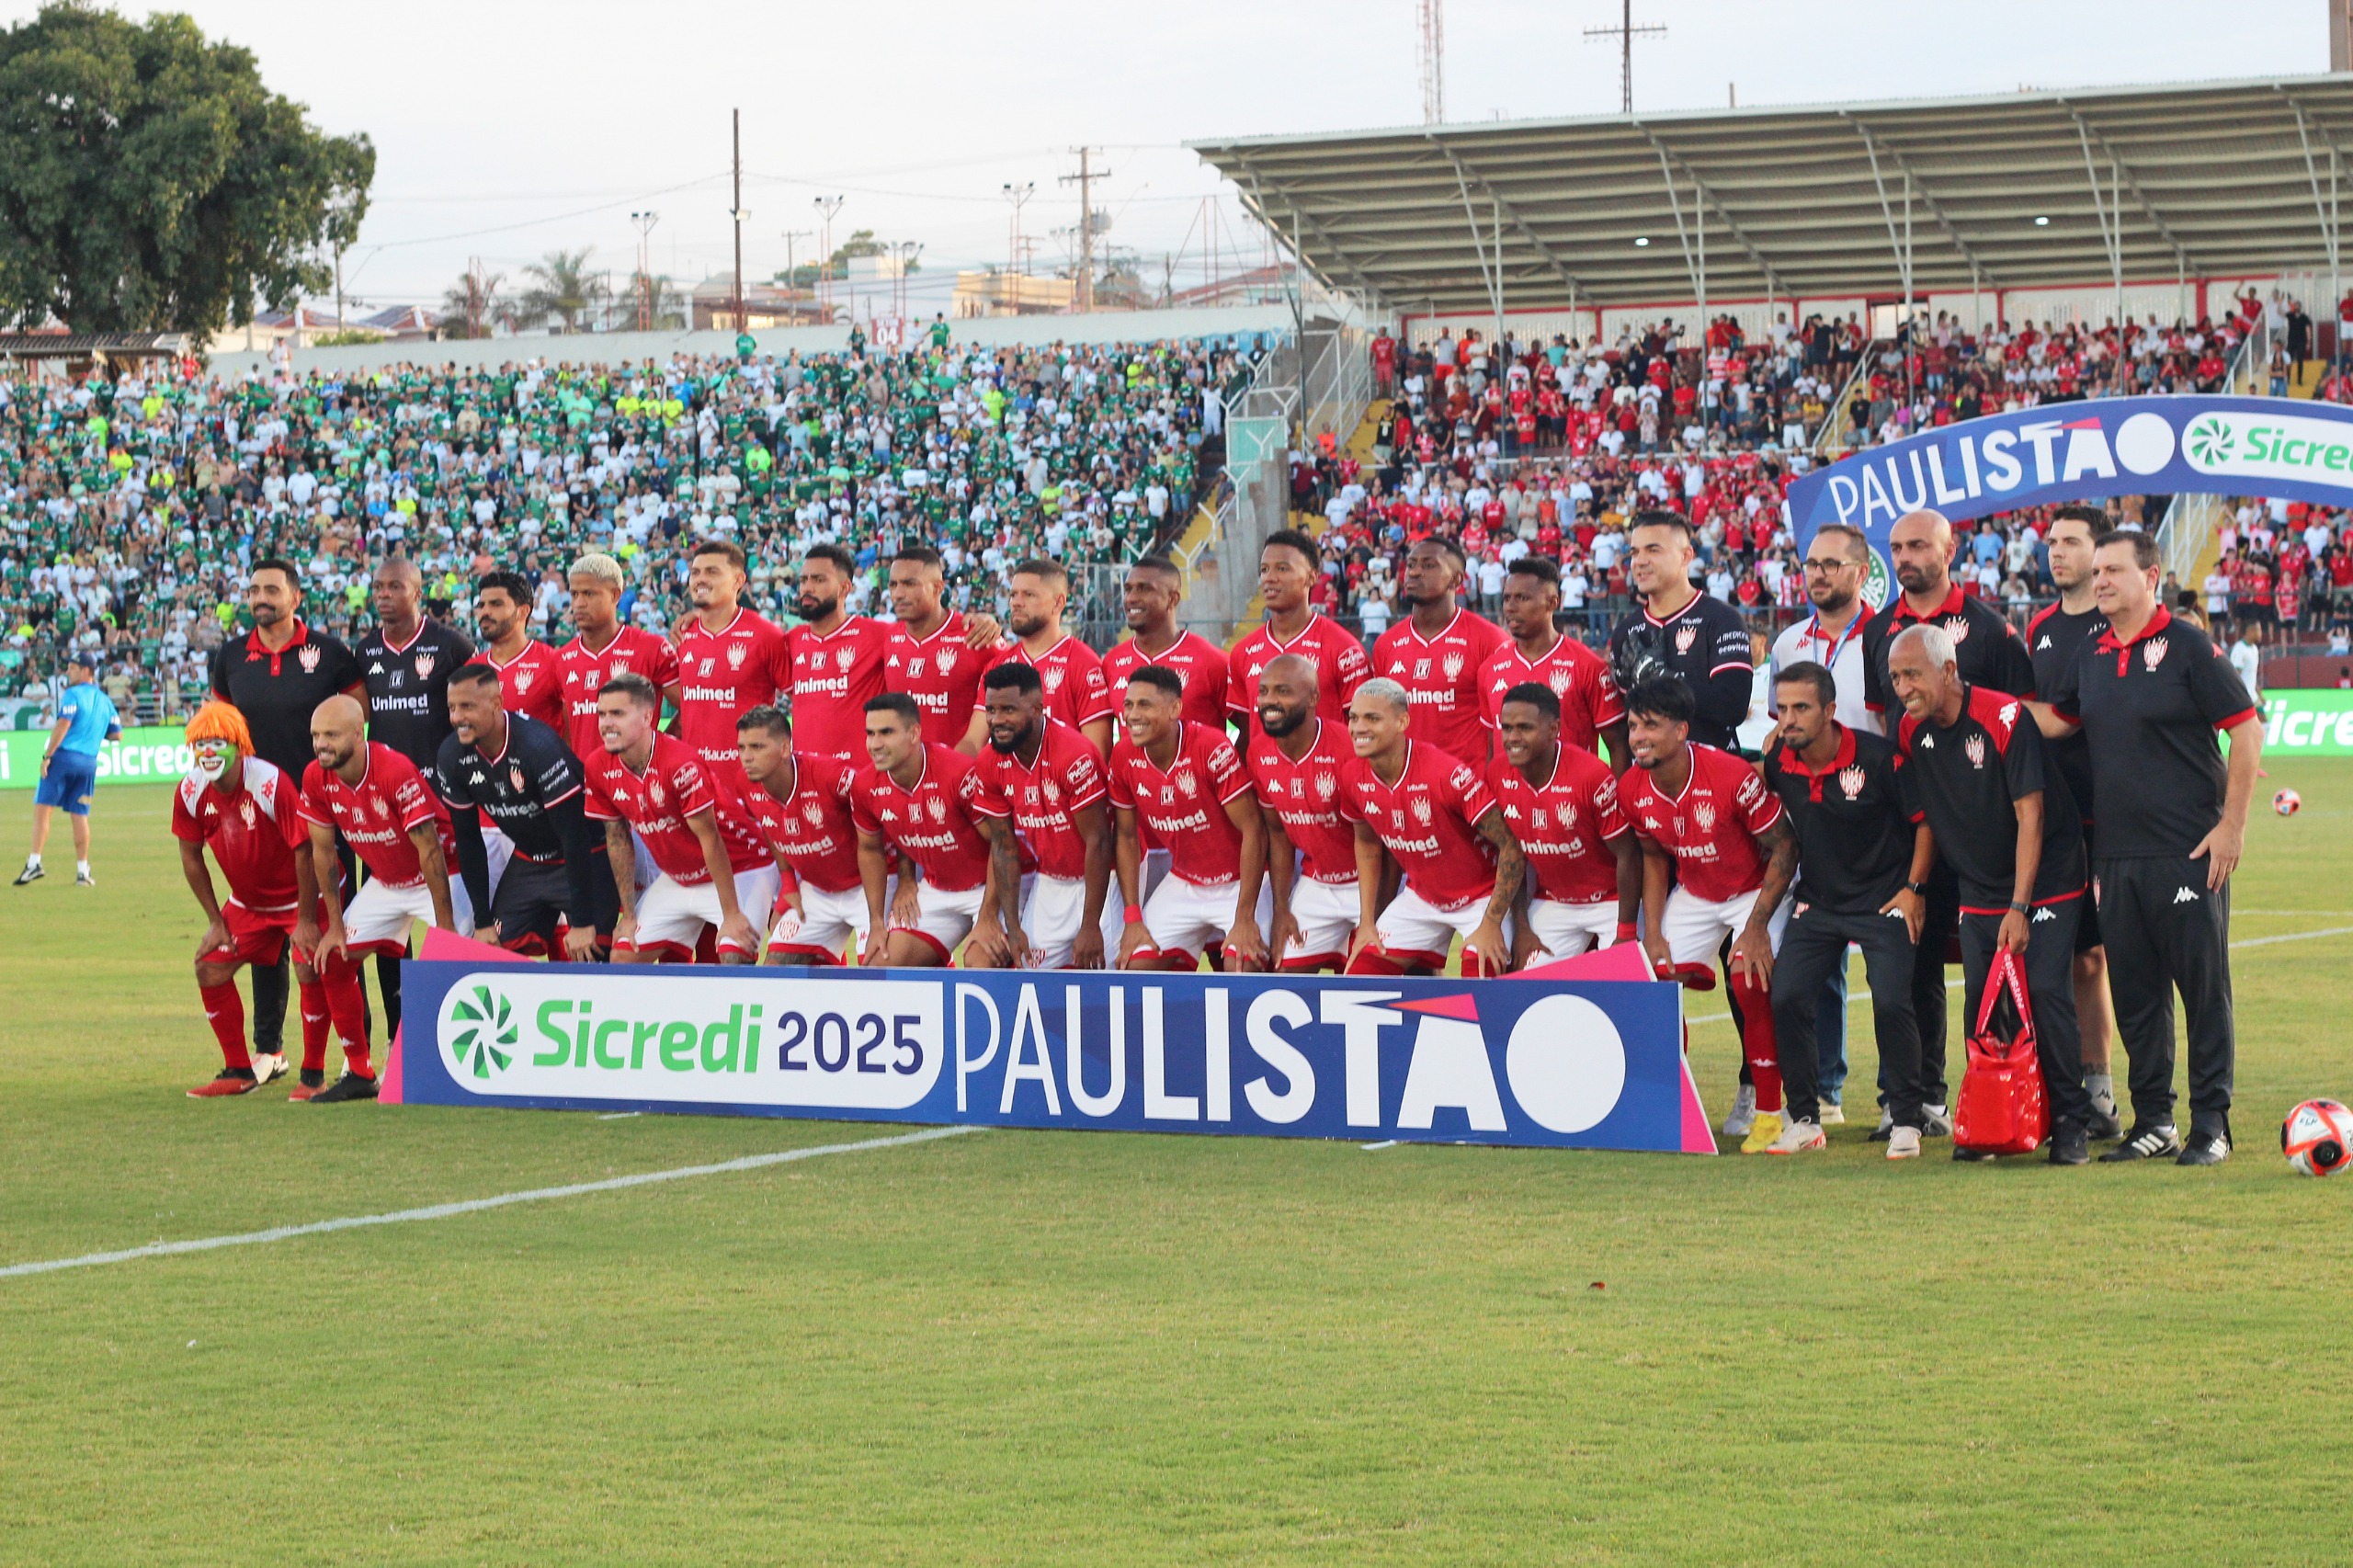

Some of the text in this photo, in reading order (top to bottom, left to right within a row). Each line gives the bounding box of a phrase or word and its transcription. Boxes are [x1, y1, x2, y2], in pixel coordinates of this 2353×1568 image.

[2244, 426, 2353, 473] Sicre
[682, 685, 735, 701] Unimed
[794, 676, 848, 695] Unimed
[372, 694, 428, 711] Unimed
[1406, 687, 1455, 704] nimed
[572, 699, 598, 716] Unim
[1438, 704, 1456, 712] Bauru
[2264, 699, 2353, 747] icre
[96, 738, 195, 776] Sicred
[1260, 756, 1278, 766] vero
[1357, 782, 1376, 792] vero
[1148, 809, 1207, 832] Unimed
[341, 827, 396, 843] Unimed
[898, 830, 955, 848] Unimed
[1381, 834, 1438, 853] Unimed
[773, 835, 834, 855] Unimed
[1677, 842, 1717, 858] med
[532, 999, 764, 1074] Sicredi
[777, 1011, 924, 1074] 2025
